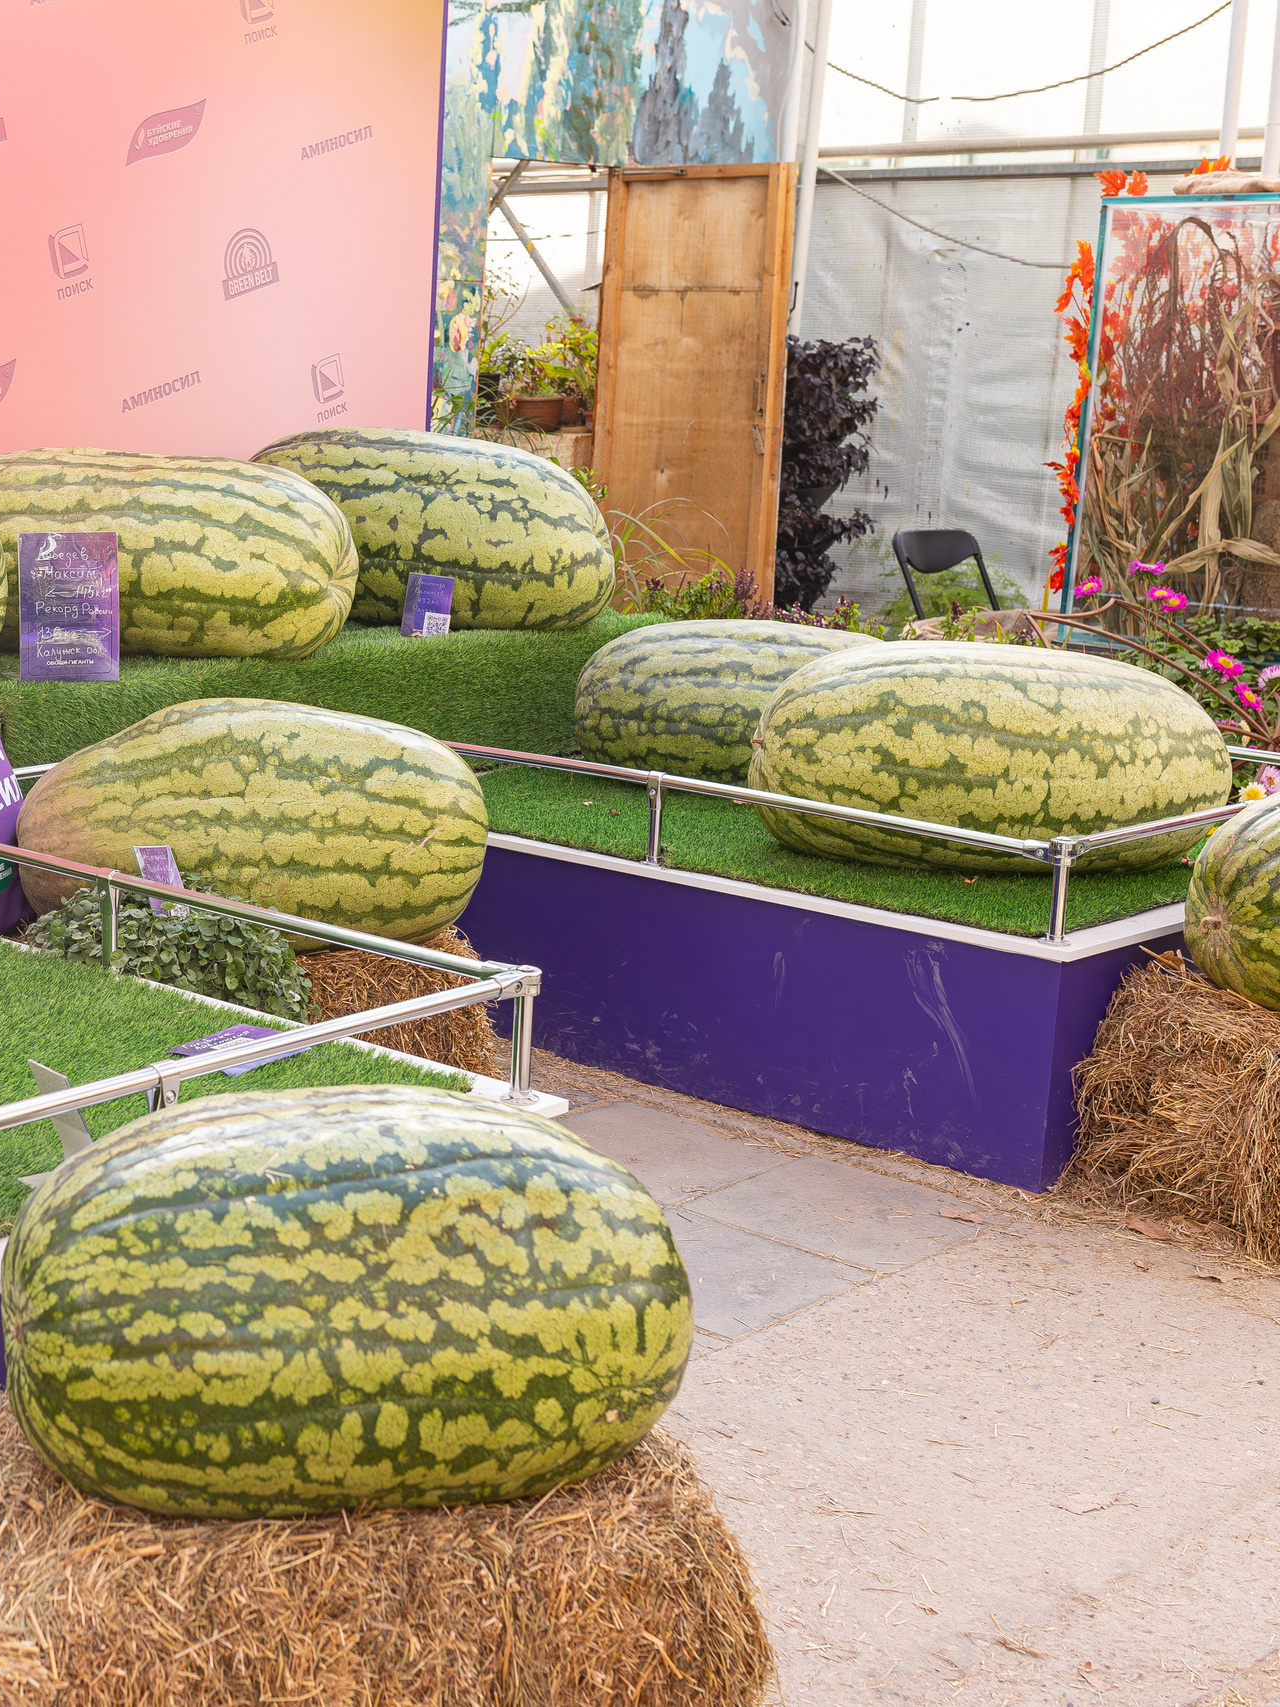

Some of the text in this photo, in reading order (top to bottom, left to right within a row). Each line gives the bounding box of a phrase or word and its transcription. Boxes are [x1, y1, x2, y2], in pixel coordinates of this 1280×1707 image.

[244, 25, 279, 45] ПОИСК
[147, 120, 182, 138] БУЙСКИЕ
[148, 125, 193, 147] УДОБРЕНИЯ
[300, 125, 374, 161] АМИНОСИЛ
[57, 278, 94, 300] ПОИСК
[228, 266, 273, 296] GREEN BELT
[121, 370, 202, 414] АМИНОСИЛ
[317, 402, 348, 423] ПОИСК
[35, 601, 79, 619] Рекорд
